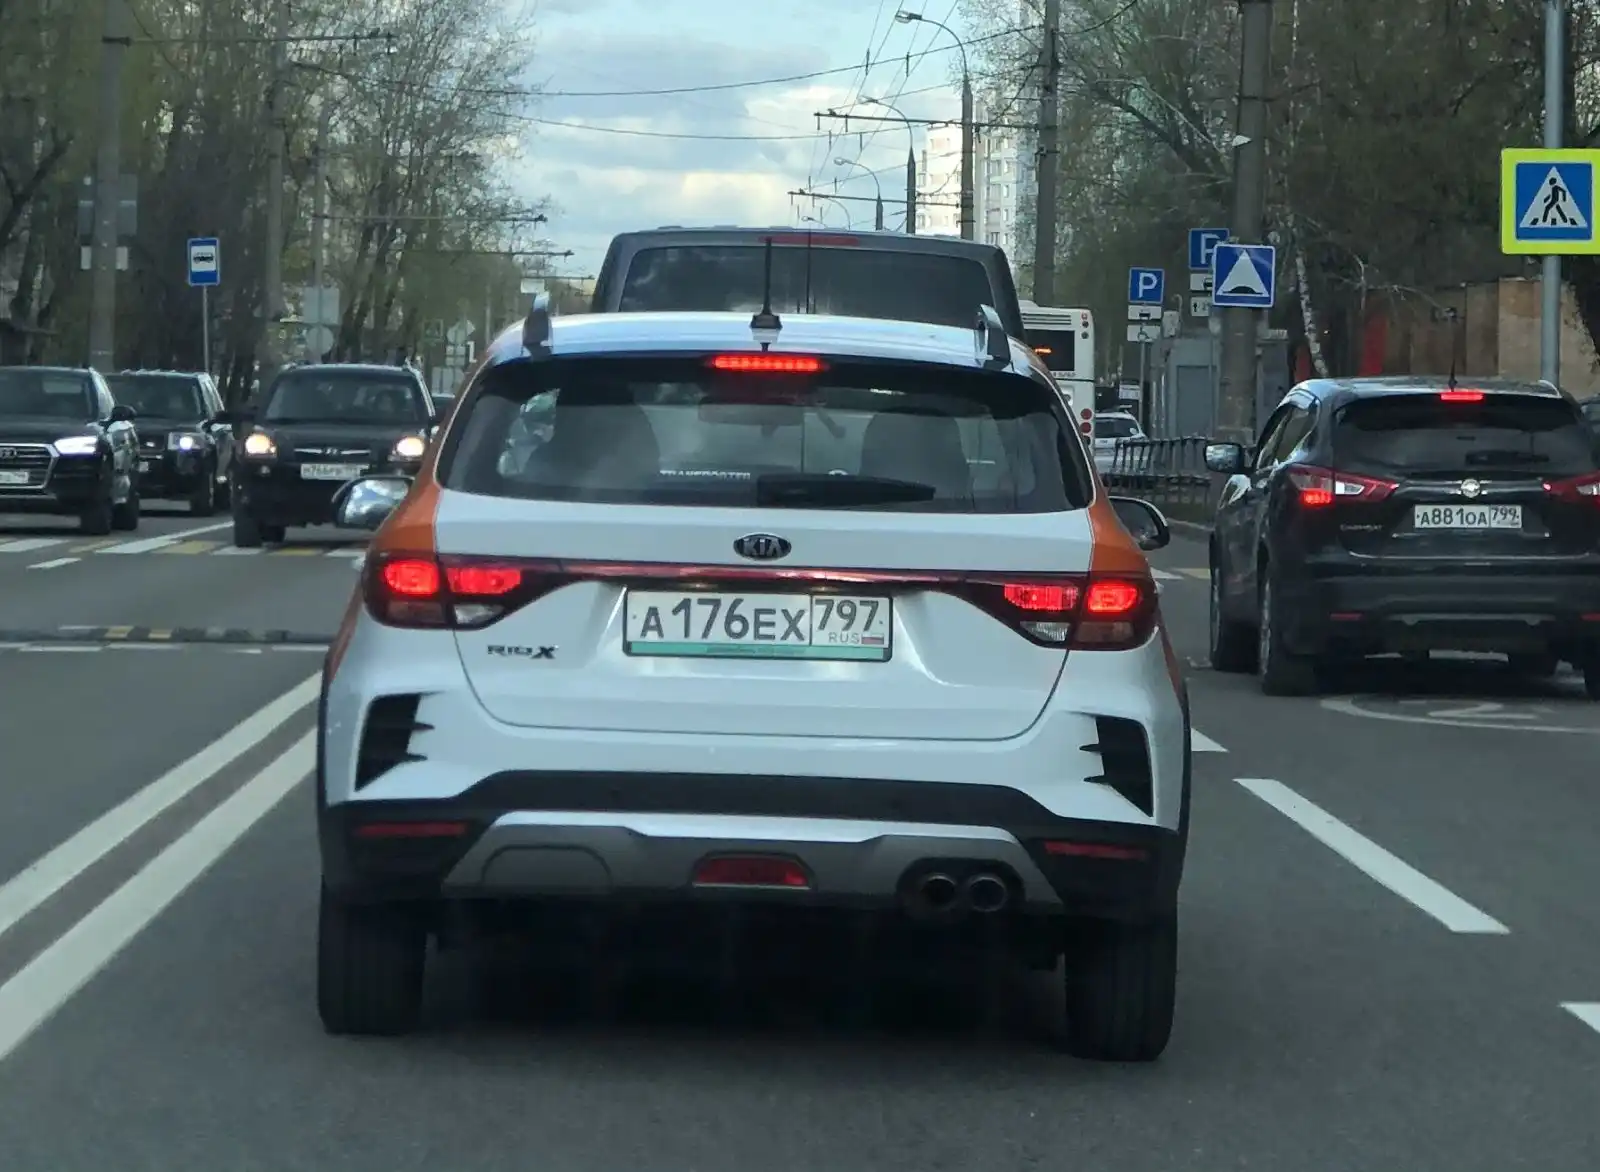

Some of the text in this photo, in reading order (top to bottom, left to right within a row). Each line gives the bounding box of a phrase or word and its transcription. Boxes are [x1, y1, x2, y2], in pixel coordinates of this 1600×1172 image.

[1139, 273, 1158, 298] P
[1491, 507, 1517, 521] 799
[743, 538, 782, 557] KIA
[815, 599, 879, 632] 797
[828, 631, 861, 645] RUS
